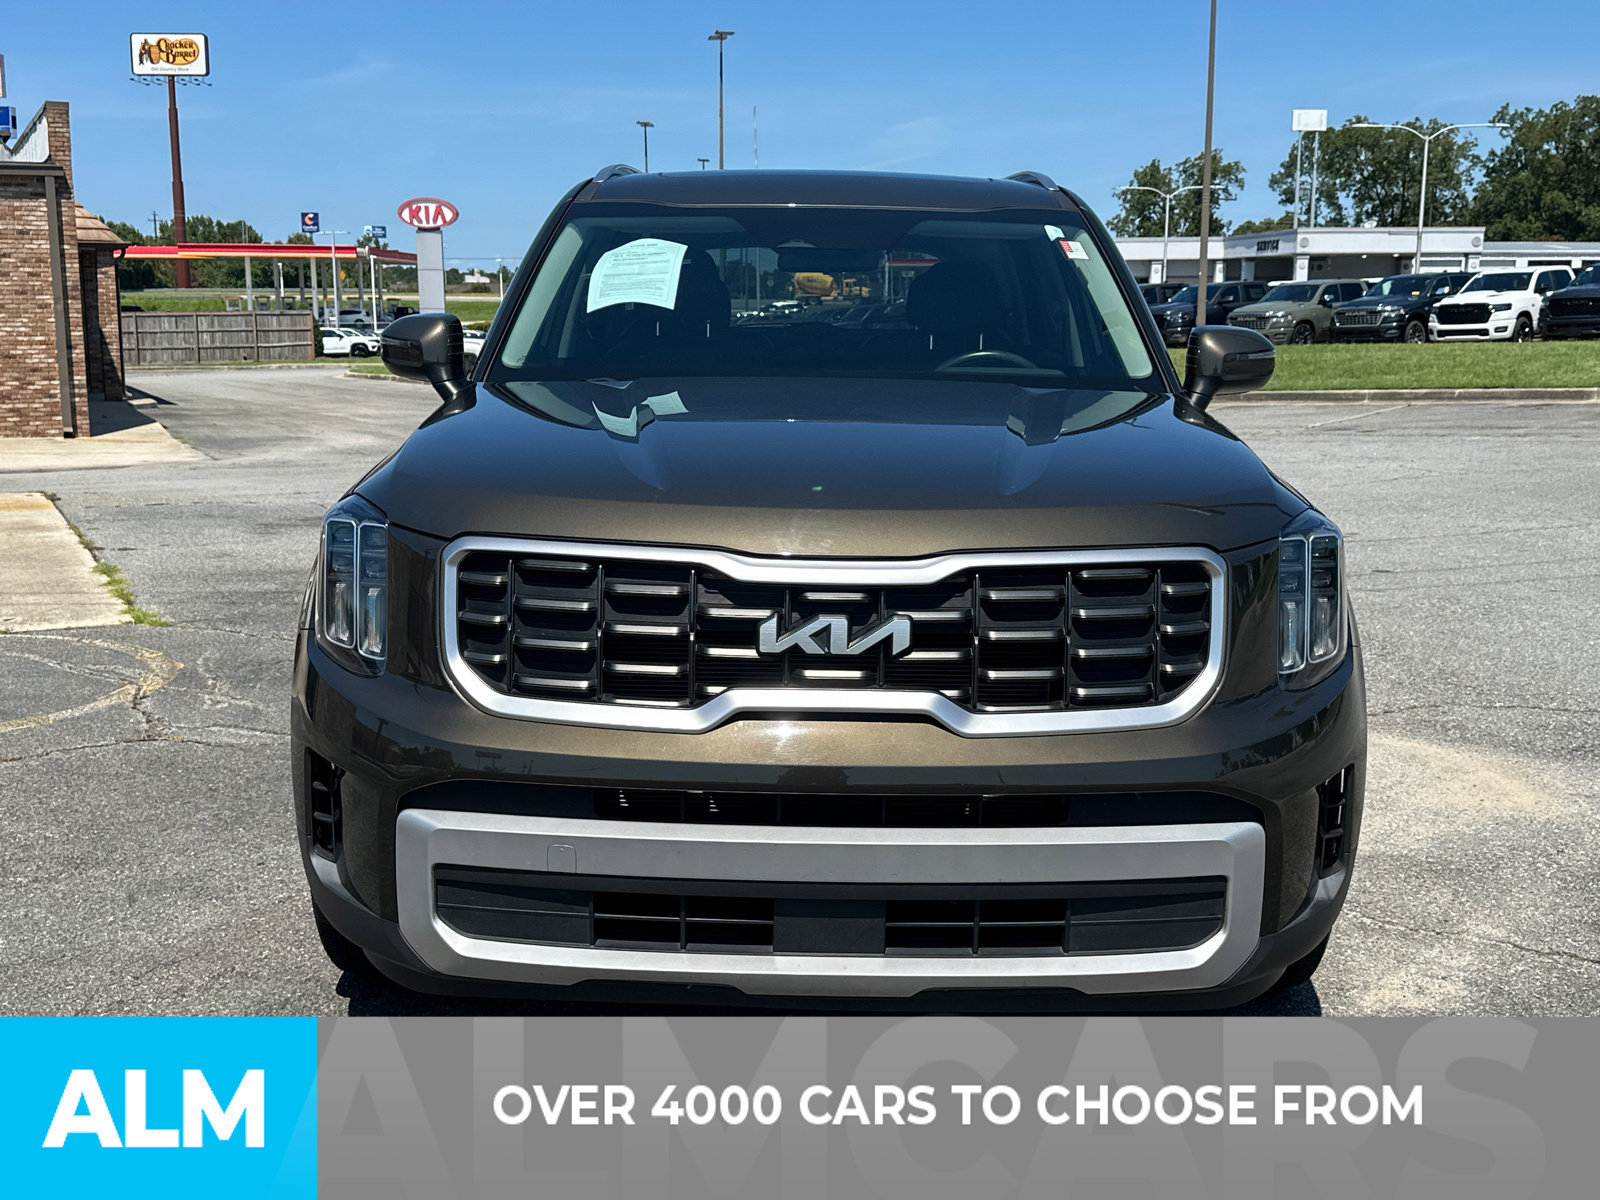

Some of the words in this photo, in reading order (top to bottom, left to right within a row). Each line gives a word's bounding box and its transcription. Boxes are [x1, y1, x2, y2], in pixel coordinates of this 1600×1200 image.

[157, 37, 194, 53] Cracker
[166, 49, 196, 63] Barrel
[408, 205, 448, 225] KIA
[1257, 239, 1280, 251] SERVICE
[758, 613, 912, 656] KIA
